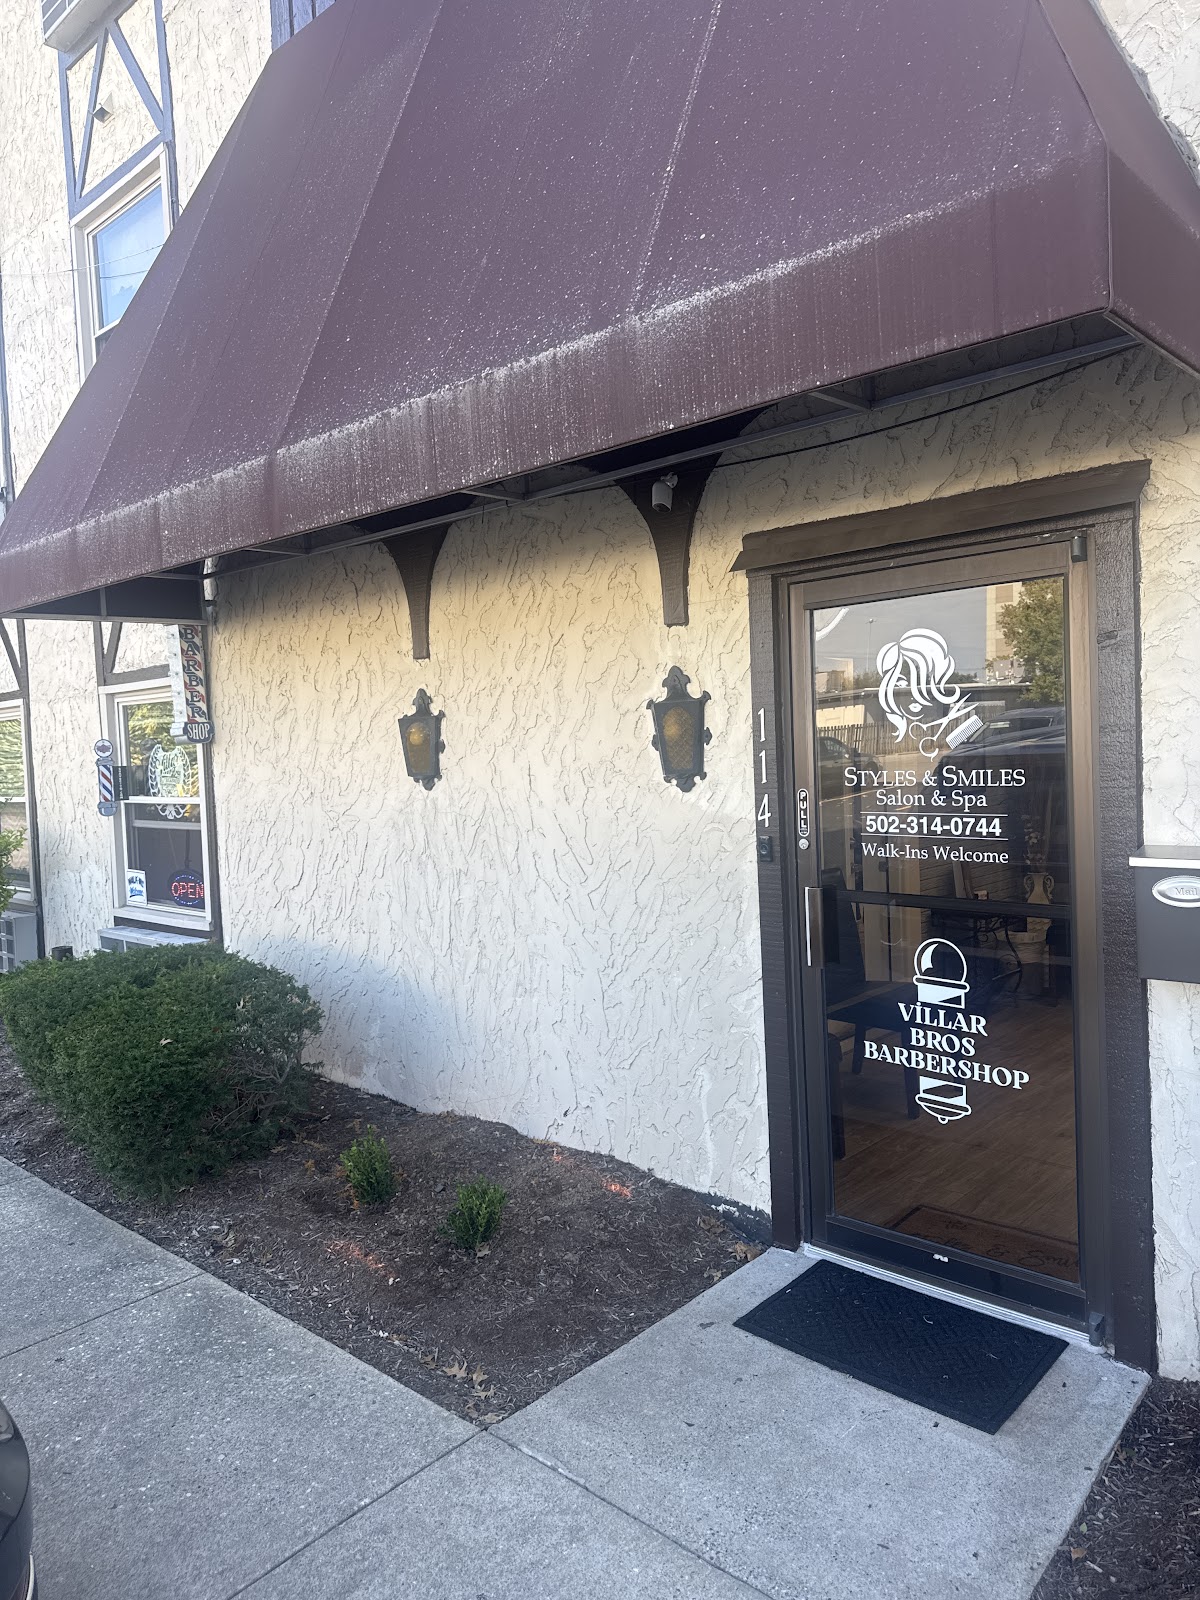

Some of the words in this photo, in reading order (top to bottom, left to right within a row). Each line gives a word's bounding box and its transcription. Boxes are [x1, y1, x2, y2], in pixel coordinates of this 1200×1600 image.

[183, 627, 206, 719] BARBER
[187, 723, 210, 740] SHOP
[922, 771, 938, 787] &
[800, 791, 808, 828] PULL
[876, 789, 926, 806] Salon
[931, 790, 946, 806] &
[951, 790, 988, 812] Spa
[865, 816, 1002, 837] 502-314-0744
[861, 843, 929, 860] Walk-Ins
[933, 846, 1009, 864] Welcome
[171, 882, 204, 899] OPEN
[1175, 887, 1198, 896] Mail
[910, 1027, 976, 1057] BROS
[863, 1040, 1030, 1090] BARBERSHOP
